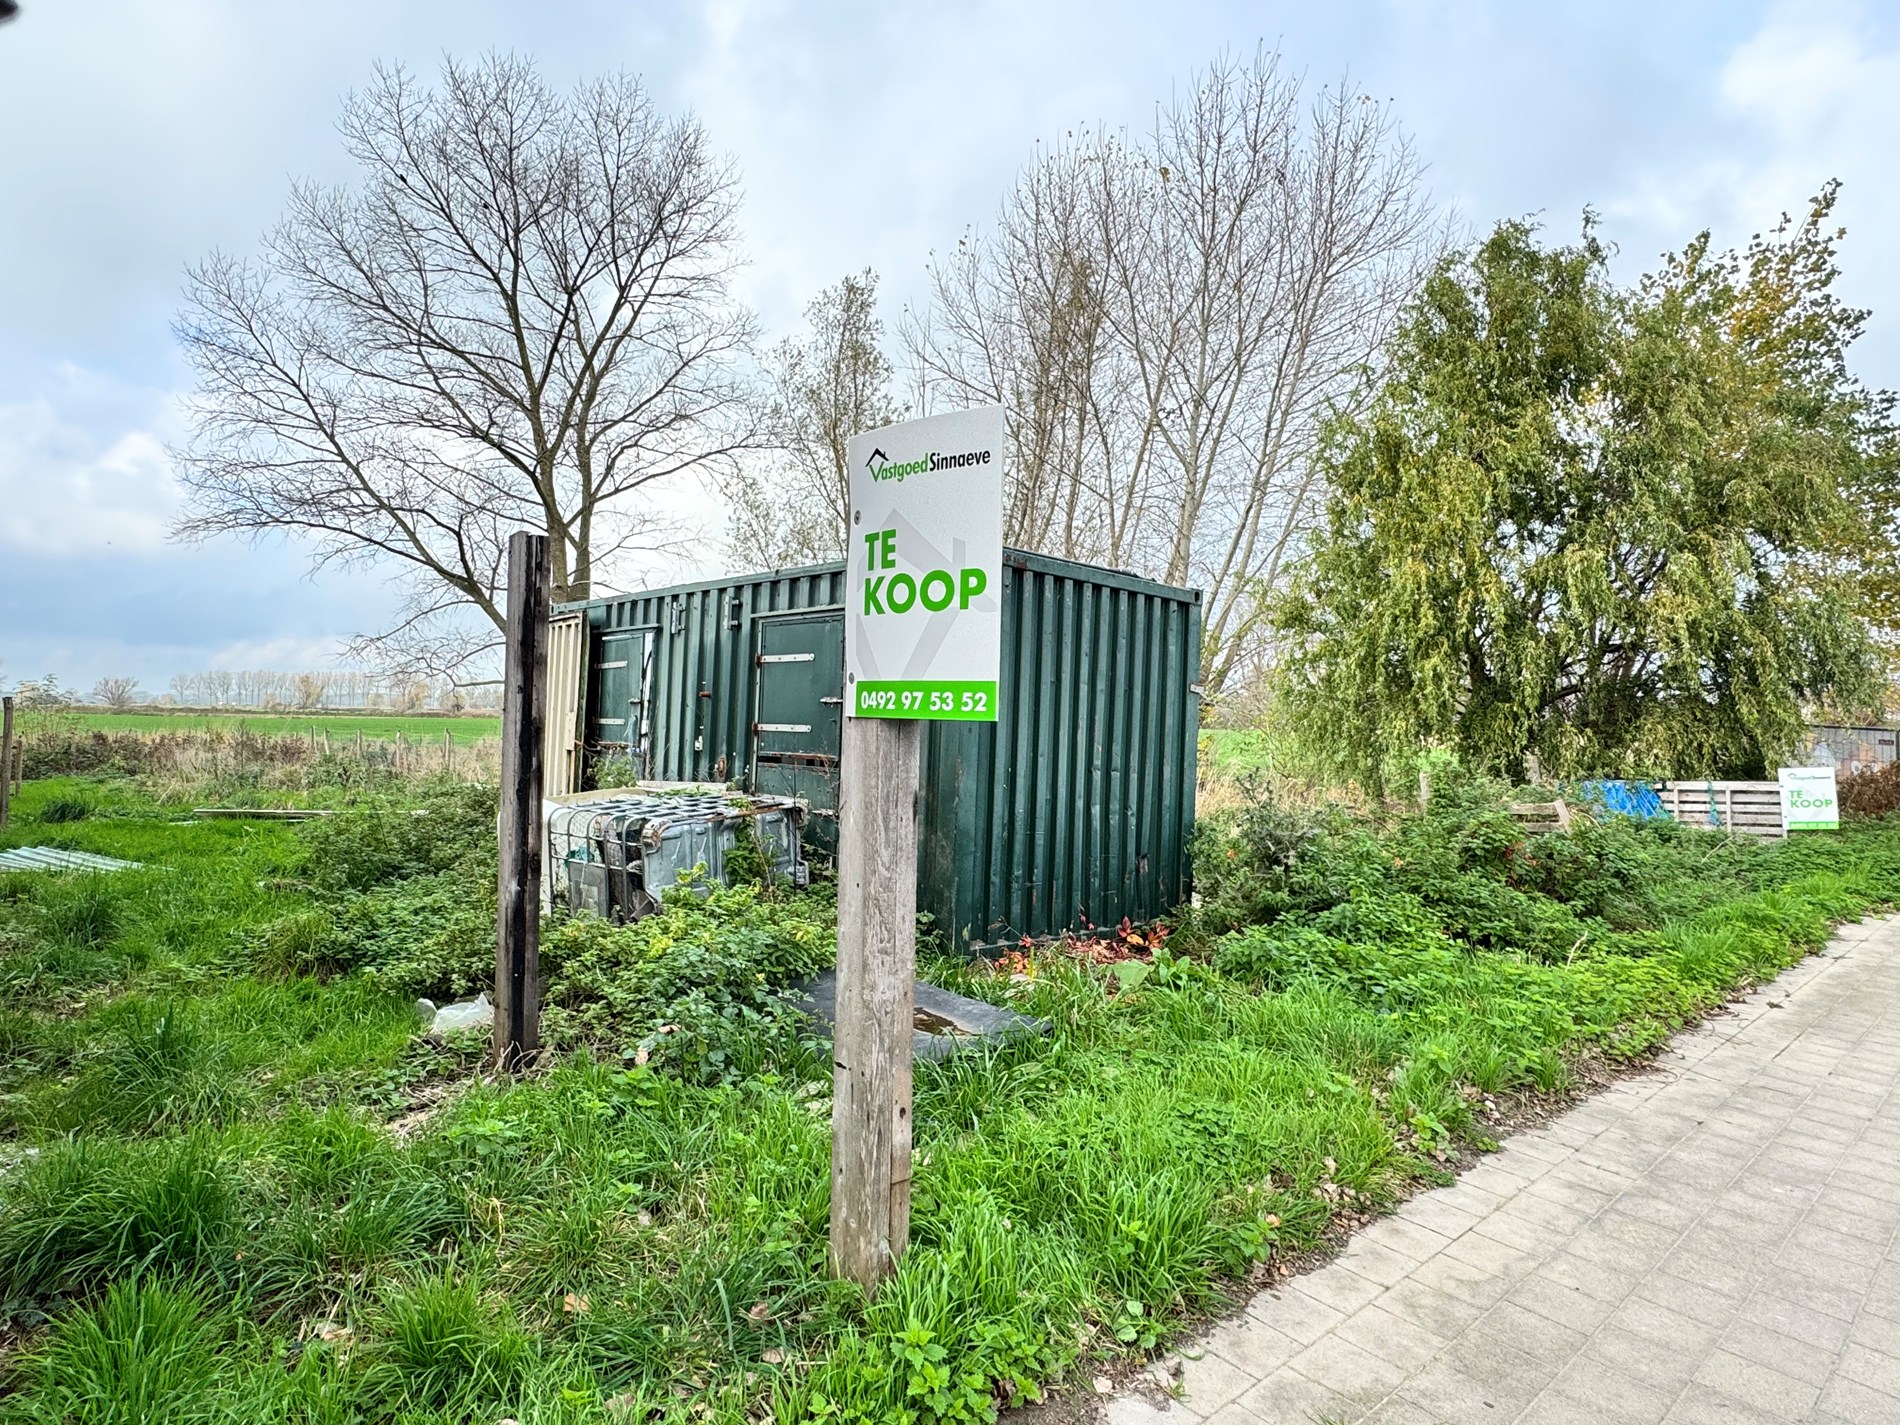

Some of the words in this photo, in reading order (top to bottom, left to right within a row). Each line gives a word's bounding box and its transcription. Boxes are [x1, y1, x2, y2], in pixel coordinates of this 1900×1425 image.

[864, 528, 897, 571] TE
[864, 568, 987, 616] KOOP
[861, 691, 896, 710] 0492
[901, 691, 924, 710] 97
[929, 691, 954, 711] 53
[961, 692, 987, 712] 52
[1788, 790, 1803, 798] TE
[1790, 799, 1833, 808] KOOP
